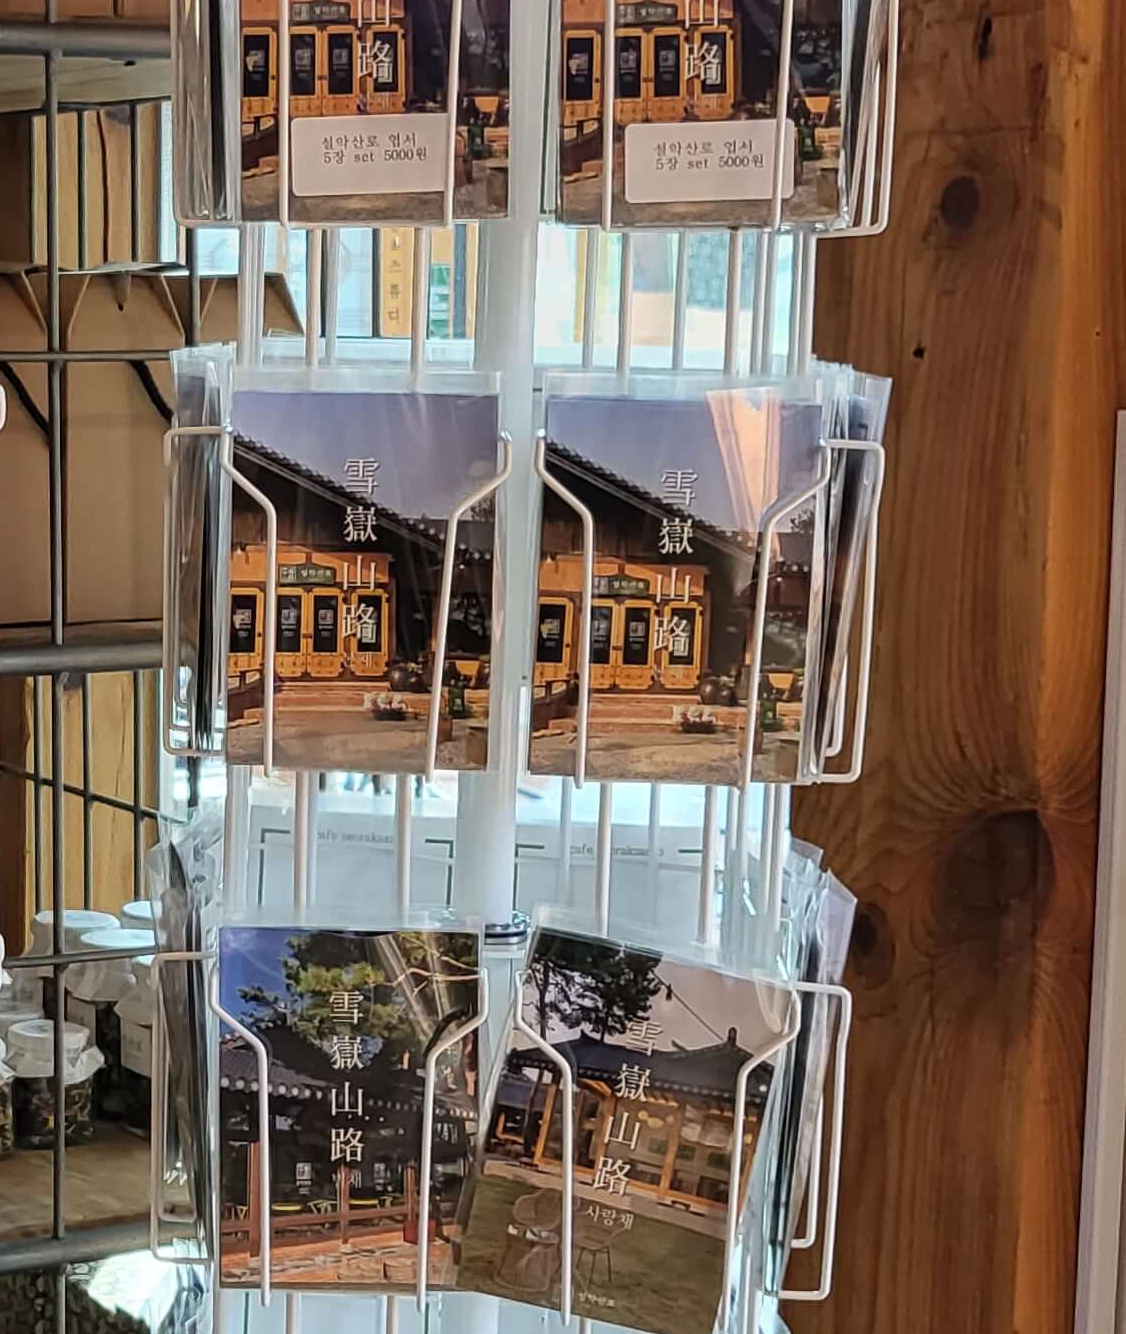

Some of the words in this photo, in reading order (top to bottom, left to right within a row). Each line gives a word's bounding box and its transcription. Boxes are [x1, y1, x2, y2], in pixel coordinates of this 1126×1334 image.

[384, 147, 427, 161] 5000원
[718, 154, 764, 168] 5000원
[341, 457, 379, 642] 雪嶽山路
[654, 469, 699, 655] 雪嶽山路
[329, 990, 365, 1162] 雪嶽山路
[591, 1018, 665, 1197] 雪嶽山路
